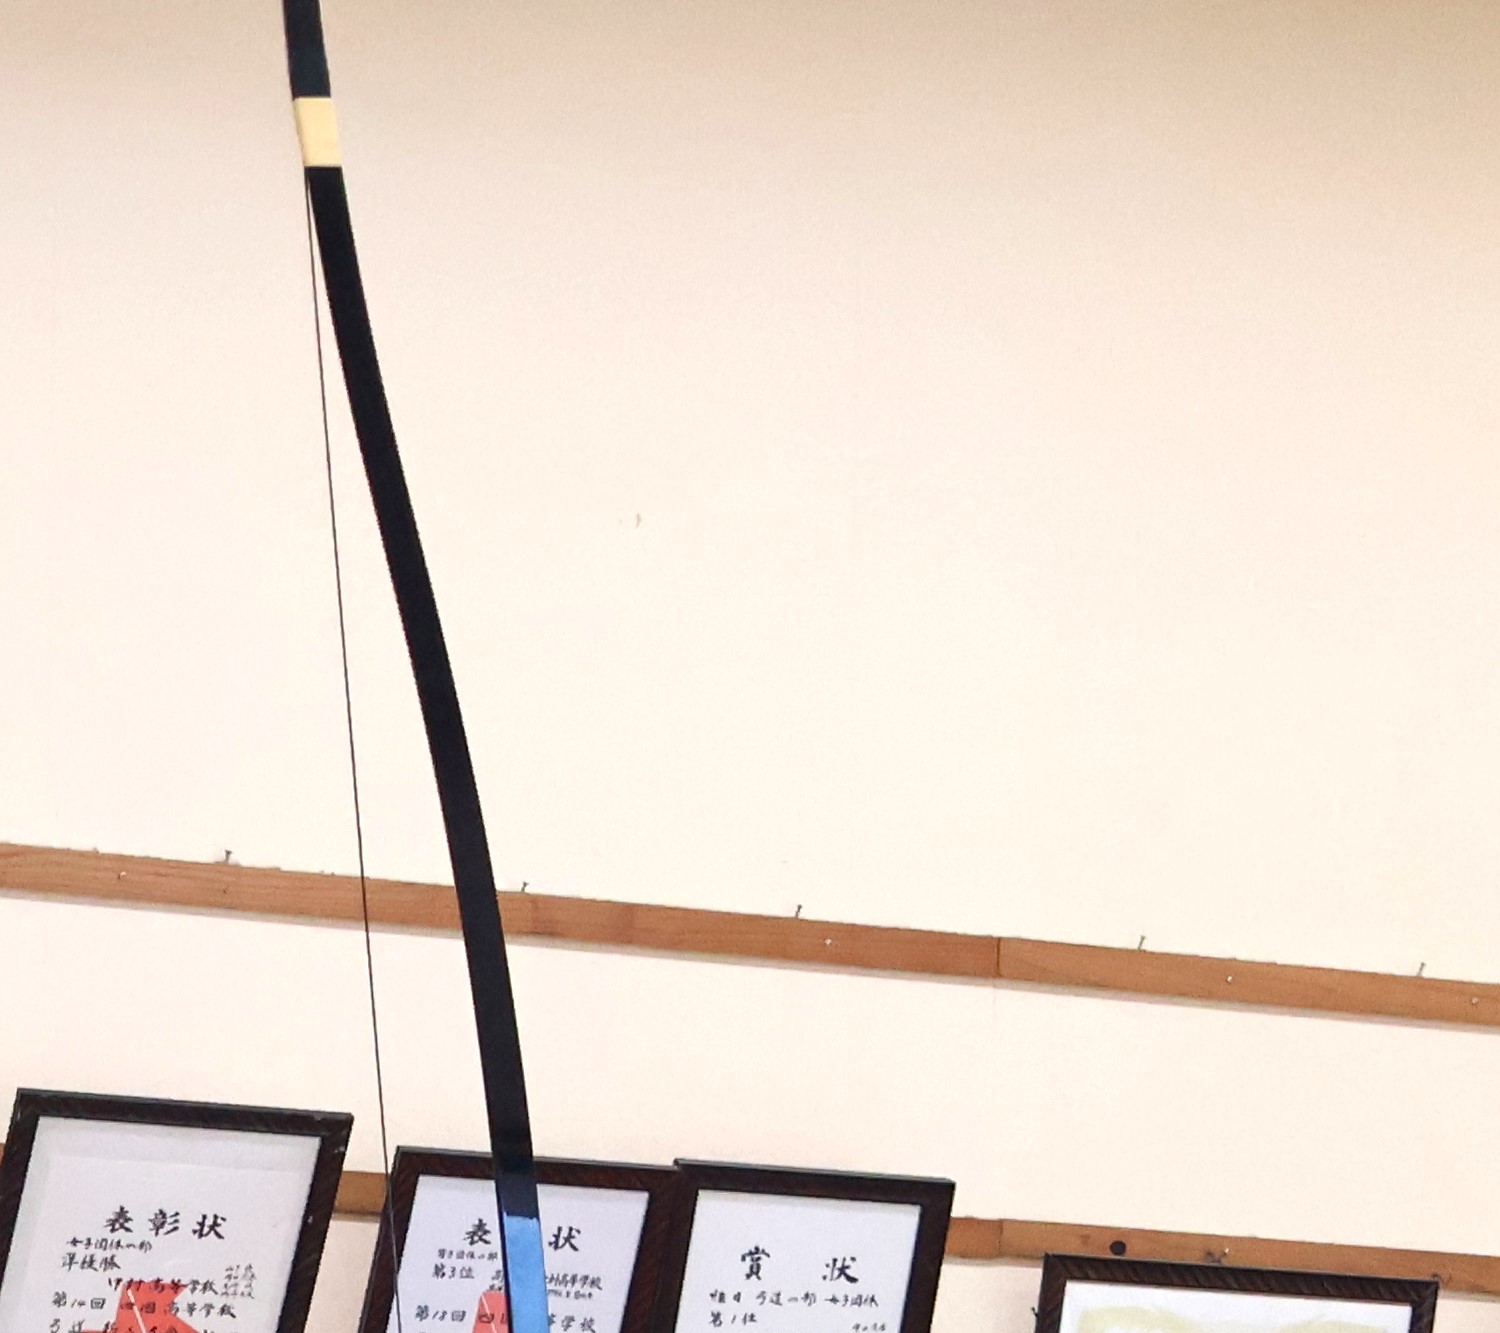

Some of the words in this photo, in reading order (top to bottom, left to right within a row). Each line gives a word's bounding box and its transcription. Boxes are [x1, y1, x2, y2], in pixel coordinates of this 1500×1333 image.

[105, 1205, 227, 1240] 表彰状
[61, 1253, 121, 1272] 準優勝
[740, 1246, 860, 1284] 賞状
